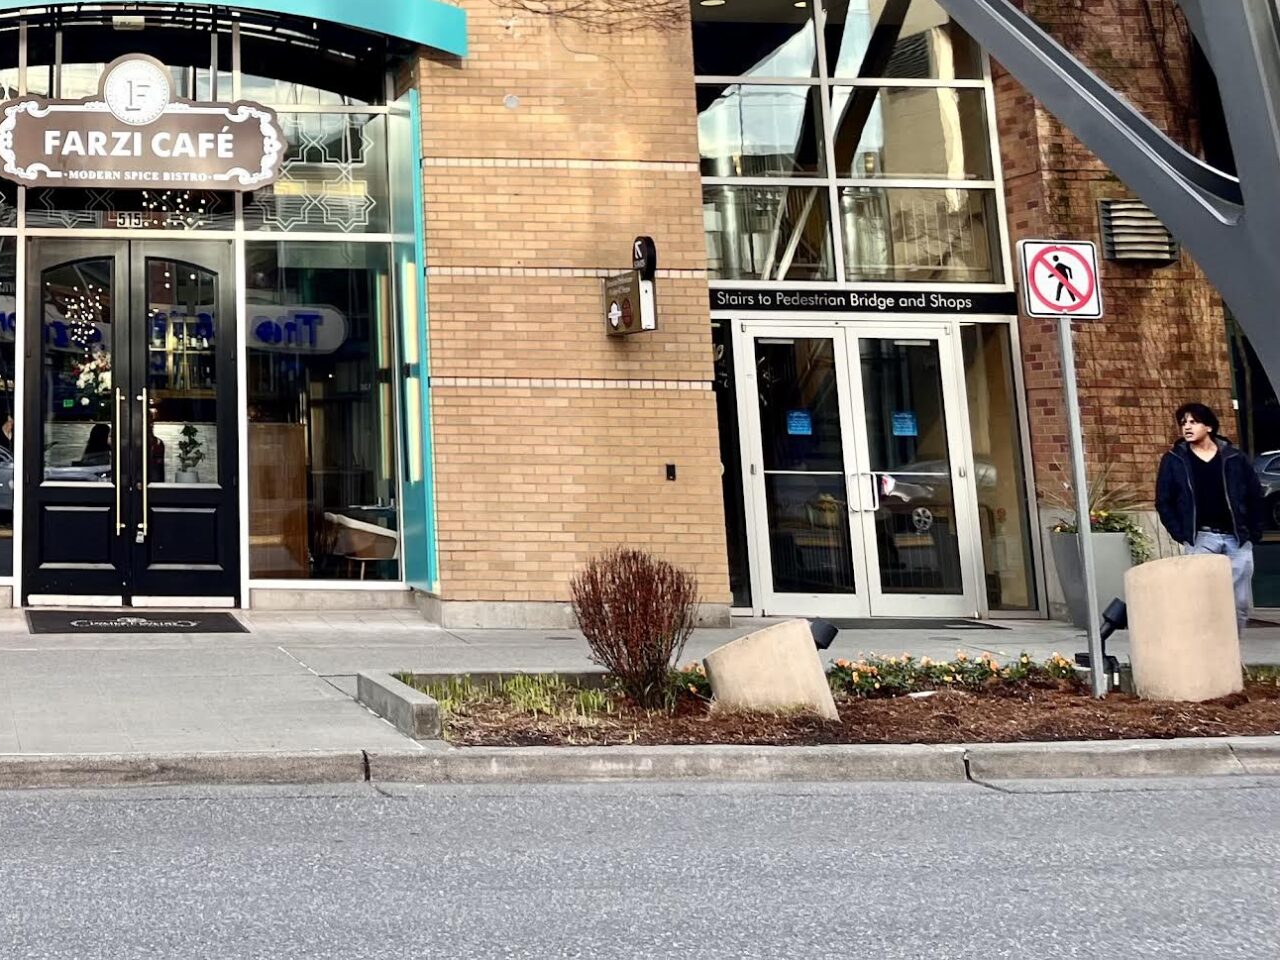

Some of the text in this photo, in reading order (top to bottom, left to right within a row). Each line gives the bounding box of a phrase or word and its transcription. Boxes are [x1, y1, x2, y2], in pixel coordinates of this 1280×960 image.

[44, 126, 234, 158] FARZI CAFÉ
[68, 170, 208, 181] MODERN SPICE BISTRO
[118, 212, 141, 226] 515
[717, 291, 972, 311] Stairs to Pedestrian Bridge and Shops
